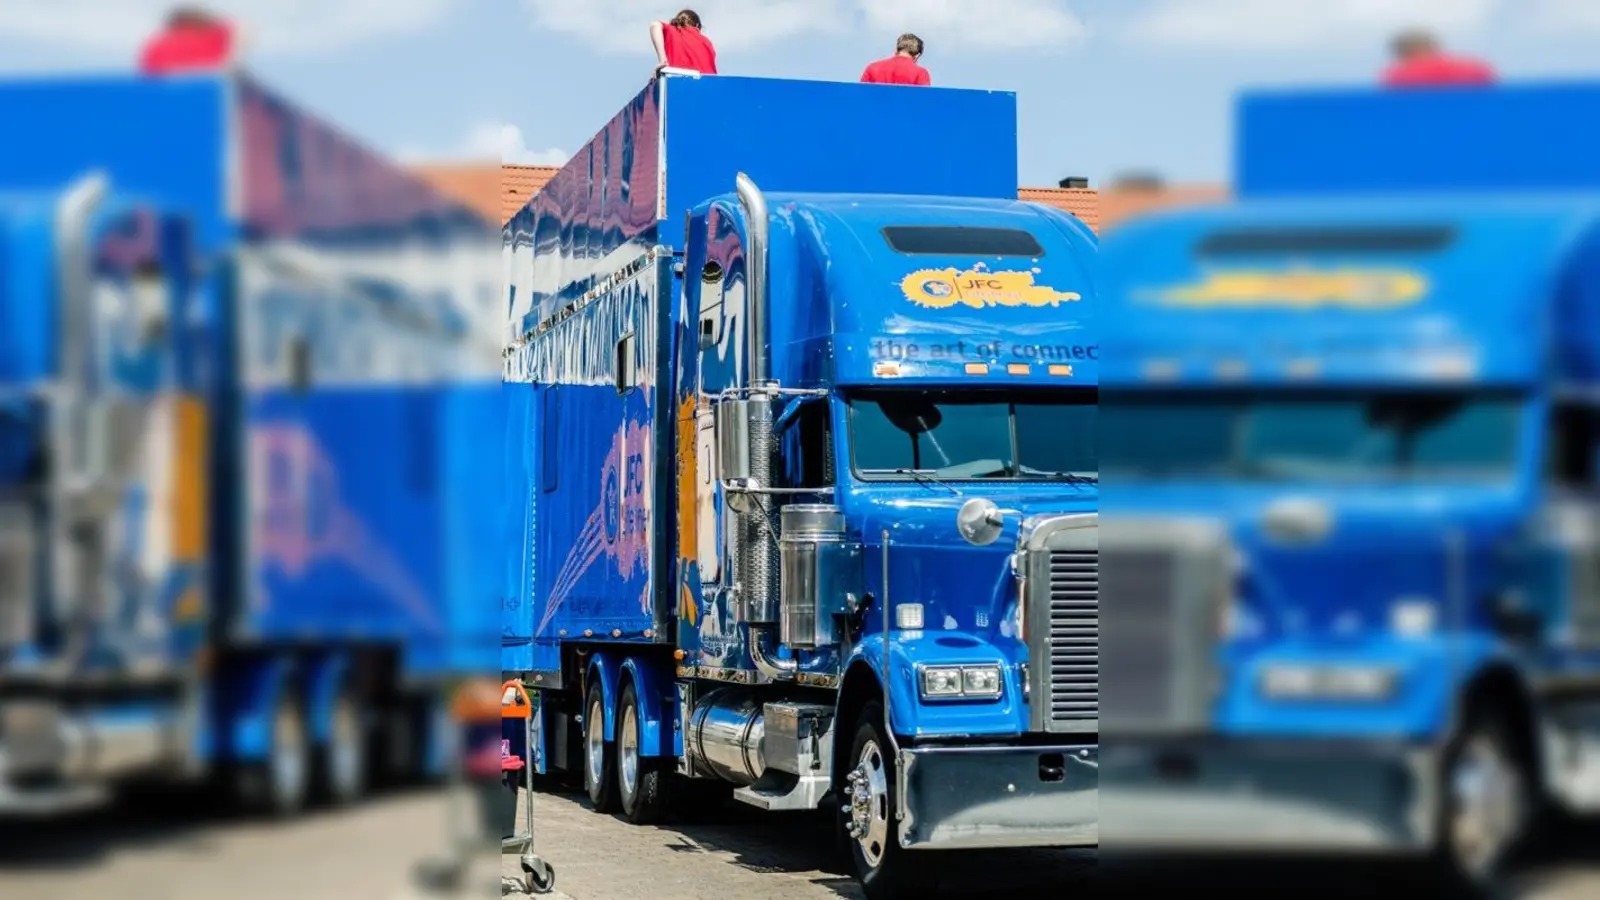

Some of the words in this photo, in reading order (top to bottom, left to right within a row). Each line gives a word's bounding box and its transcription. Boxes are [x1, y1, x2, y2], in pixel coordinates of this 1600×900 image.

[963, 279, 1002, 289] JFC
[875, 340, 919, 358] the
[930, 341, 967, 358] art
[976, 339, 1003, 358] of
[624, 453, 642, 497] JFC
